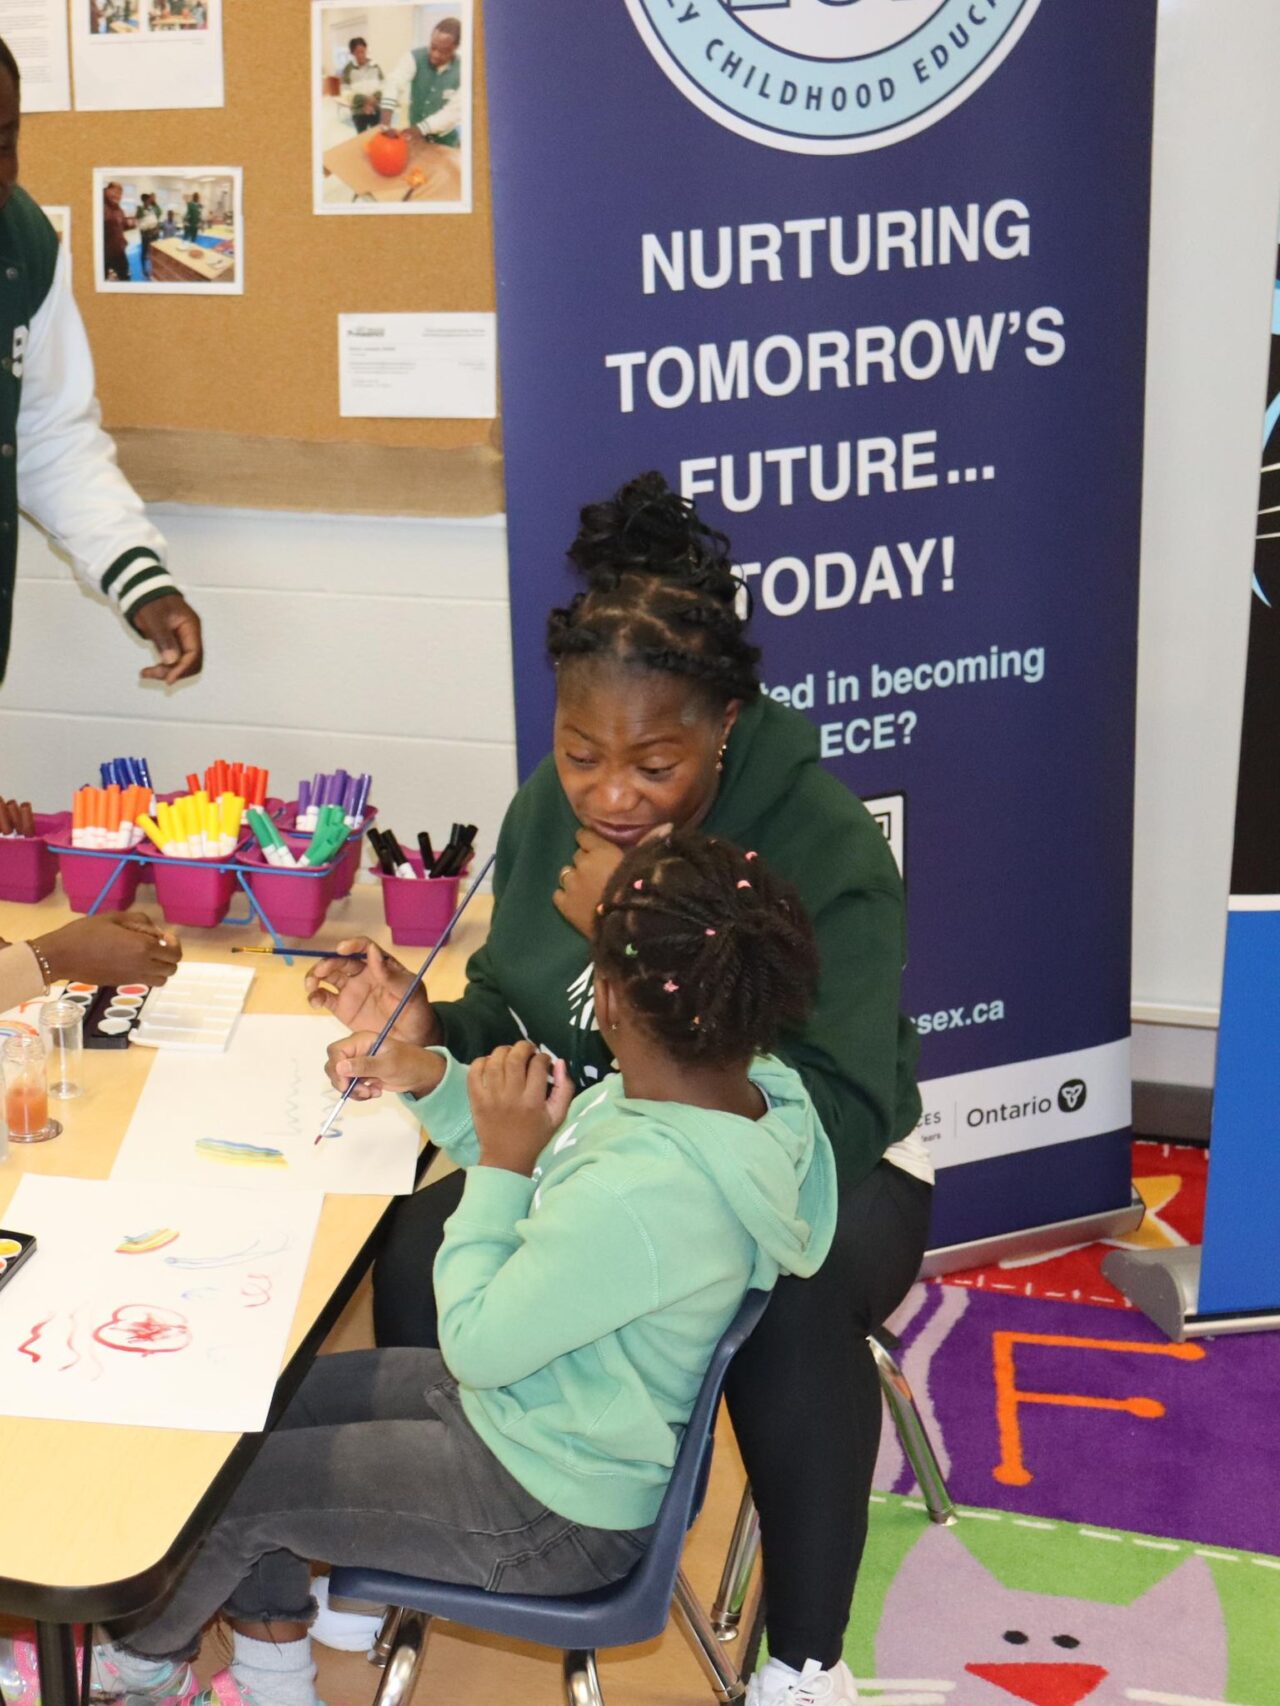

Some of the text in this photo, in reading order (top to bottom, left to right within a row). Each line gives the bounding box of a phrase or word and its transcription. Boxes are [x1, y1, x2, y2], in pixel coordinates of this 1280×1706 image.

[704, 38, 896, 112] CHILDHOOD
[911, 0, 996, 83] EDUC
[641, 199, 1031, 294] NURTURING
[605, 306, 1066, 412] TOMORROW'S
[679, 430, 996, 512] FUTURE...
[730, 536, 955, 622] TODAY!
[827, 670, 859, 705] in
[871, 645, 1045, 699] becoming
[820, 710, 917, 758] ECE?
[909, 999, 1005, 1035] sex.ca
[966, 1096, 1052, 1127] Ontario
[992, 1331, 1207, 1486] F
